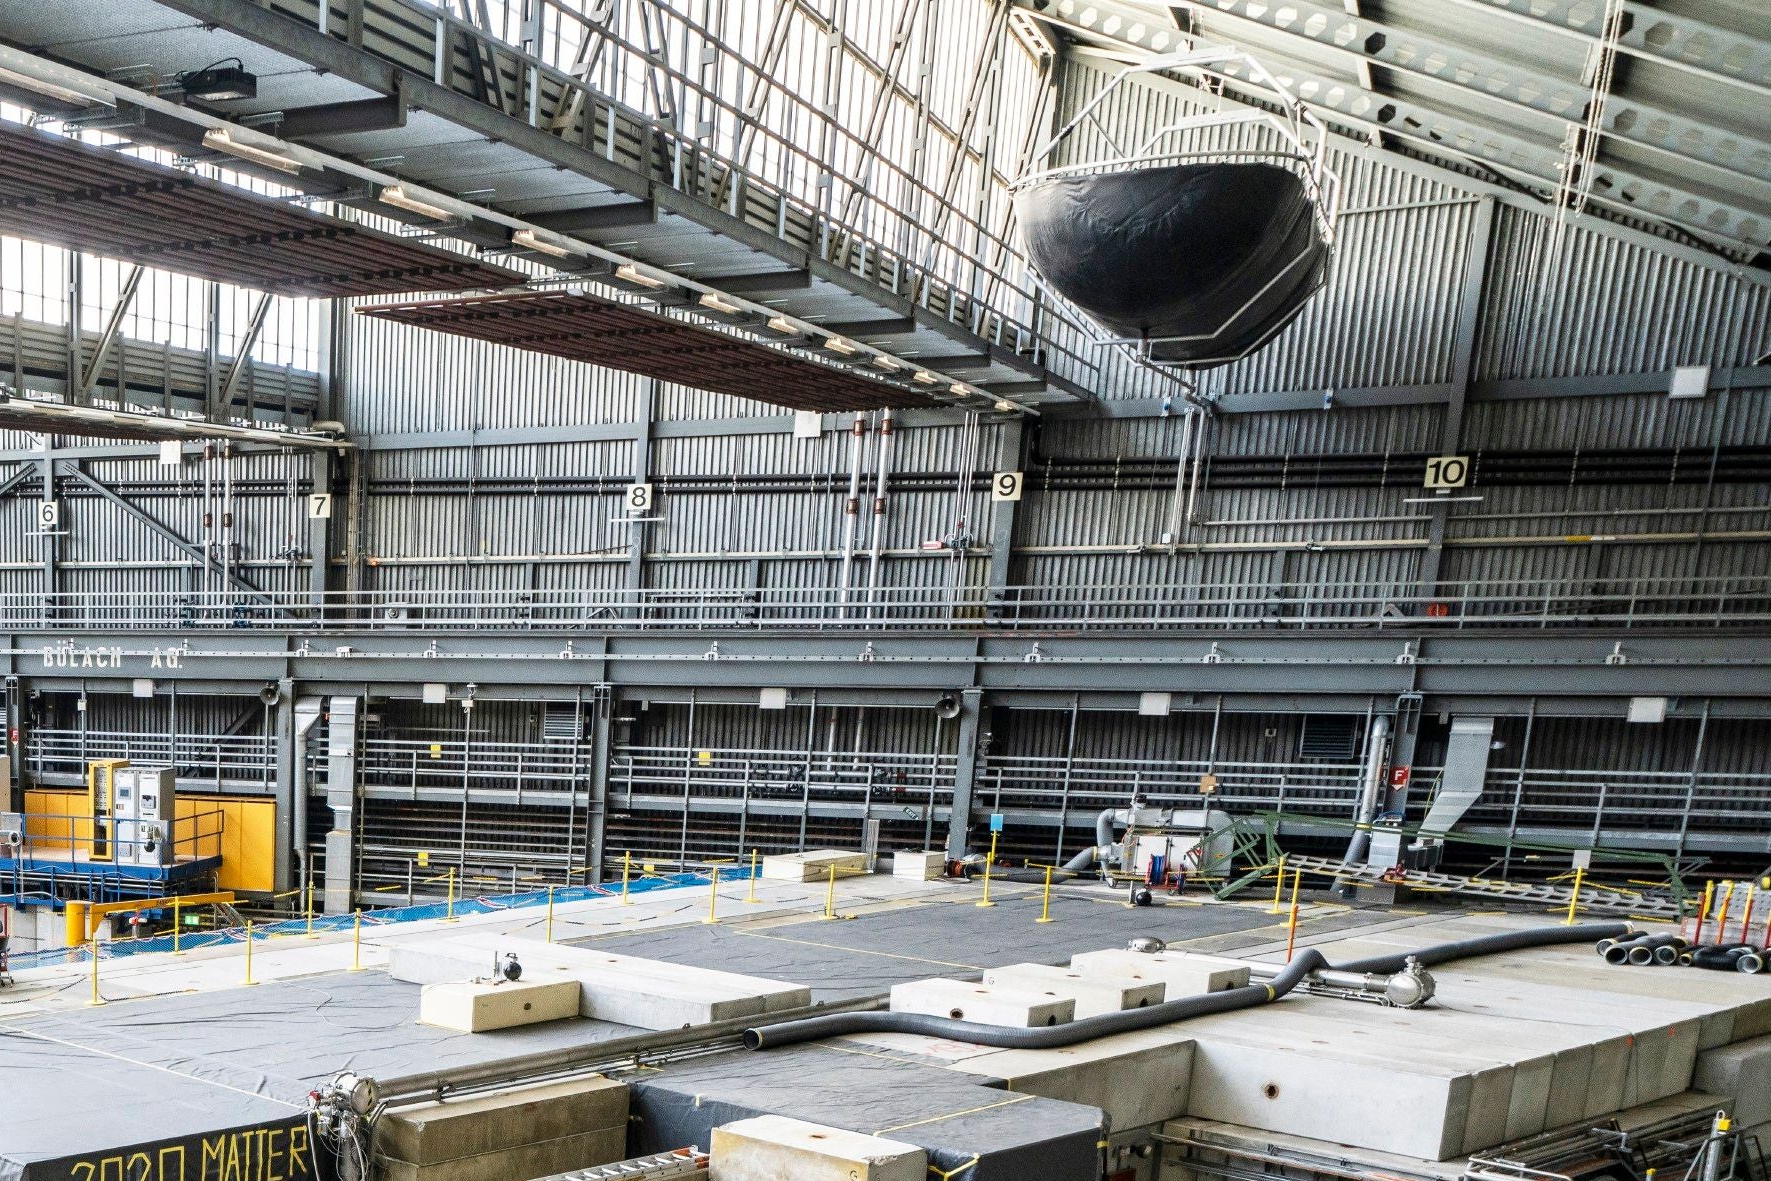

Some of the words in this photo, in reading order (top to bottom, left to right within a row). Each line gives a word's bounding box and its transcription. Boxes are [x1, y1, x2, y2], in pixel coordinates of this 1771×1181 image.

[1429, 460, 1465, 484] 10
[998, 474, 1017, 496] 9
[314, 496, 327, 515] 7
[631, 486, 647, 507] 8
[42, 504, 54, 522] 6
[43, 639, 121, 668] BÜLACH
[1394, 769, 1405, 781] F
